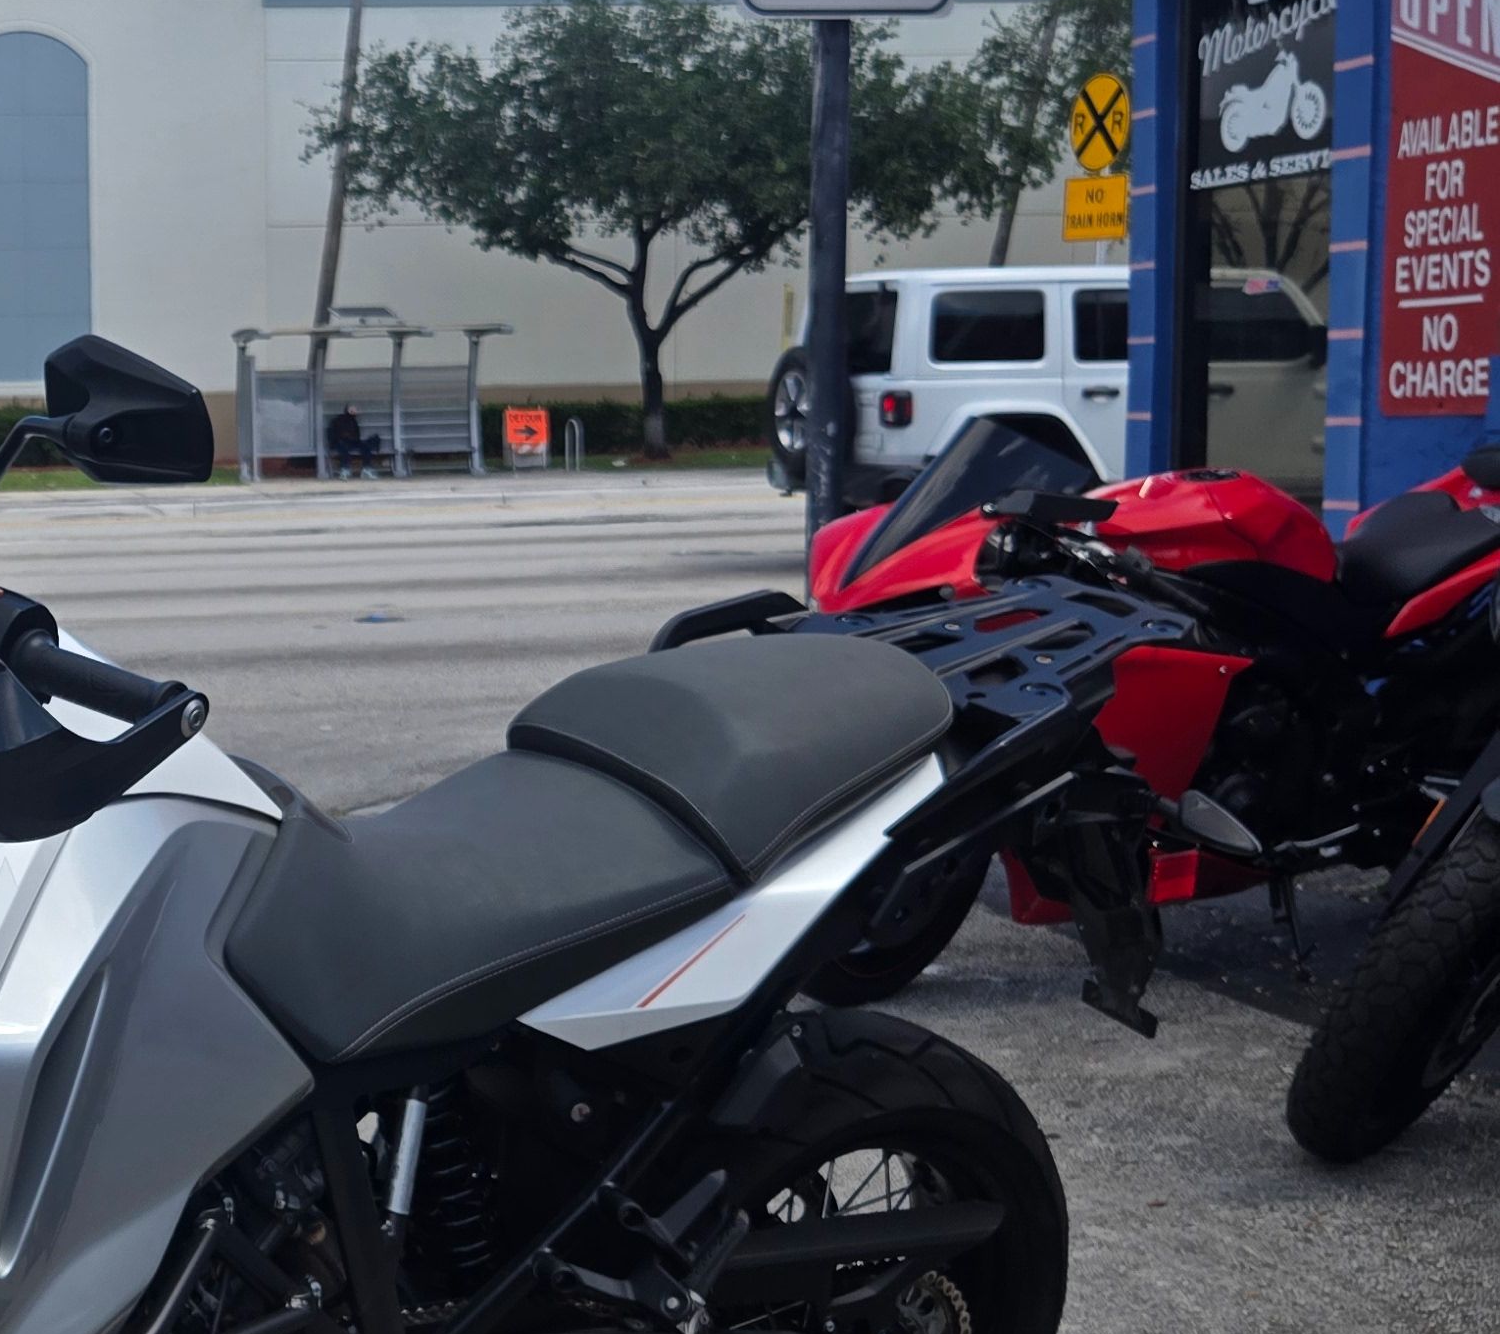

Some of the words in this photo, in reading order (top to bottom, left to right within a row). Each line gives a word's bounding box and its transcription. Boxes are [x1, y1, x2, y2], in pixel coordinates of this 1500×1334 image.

[1073, 113, 1086, 135] R
[1111, 109, 1125, 134] R
[1397, 105, 1498, 159] AVAILABLE
[1085, 188, 1105, 204] NO
[1190, 160, 1249, 191] SALES
[1251, 160, 1267, 181] &
[1424, 158, 1465, 202] FOR
[1096, 211, 1124, 228] HORN
[1404, 203, 1484, 249] SPECIAL
[1395, 248, 1491, 294] EVENTS
[1422, 313, 1459, 353] NO
[1388, 357, 1490, 399] CHARGE
